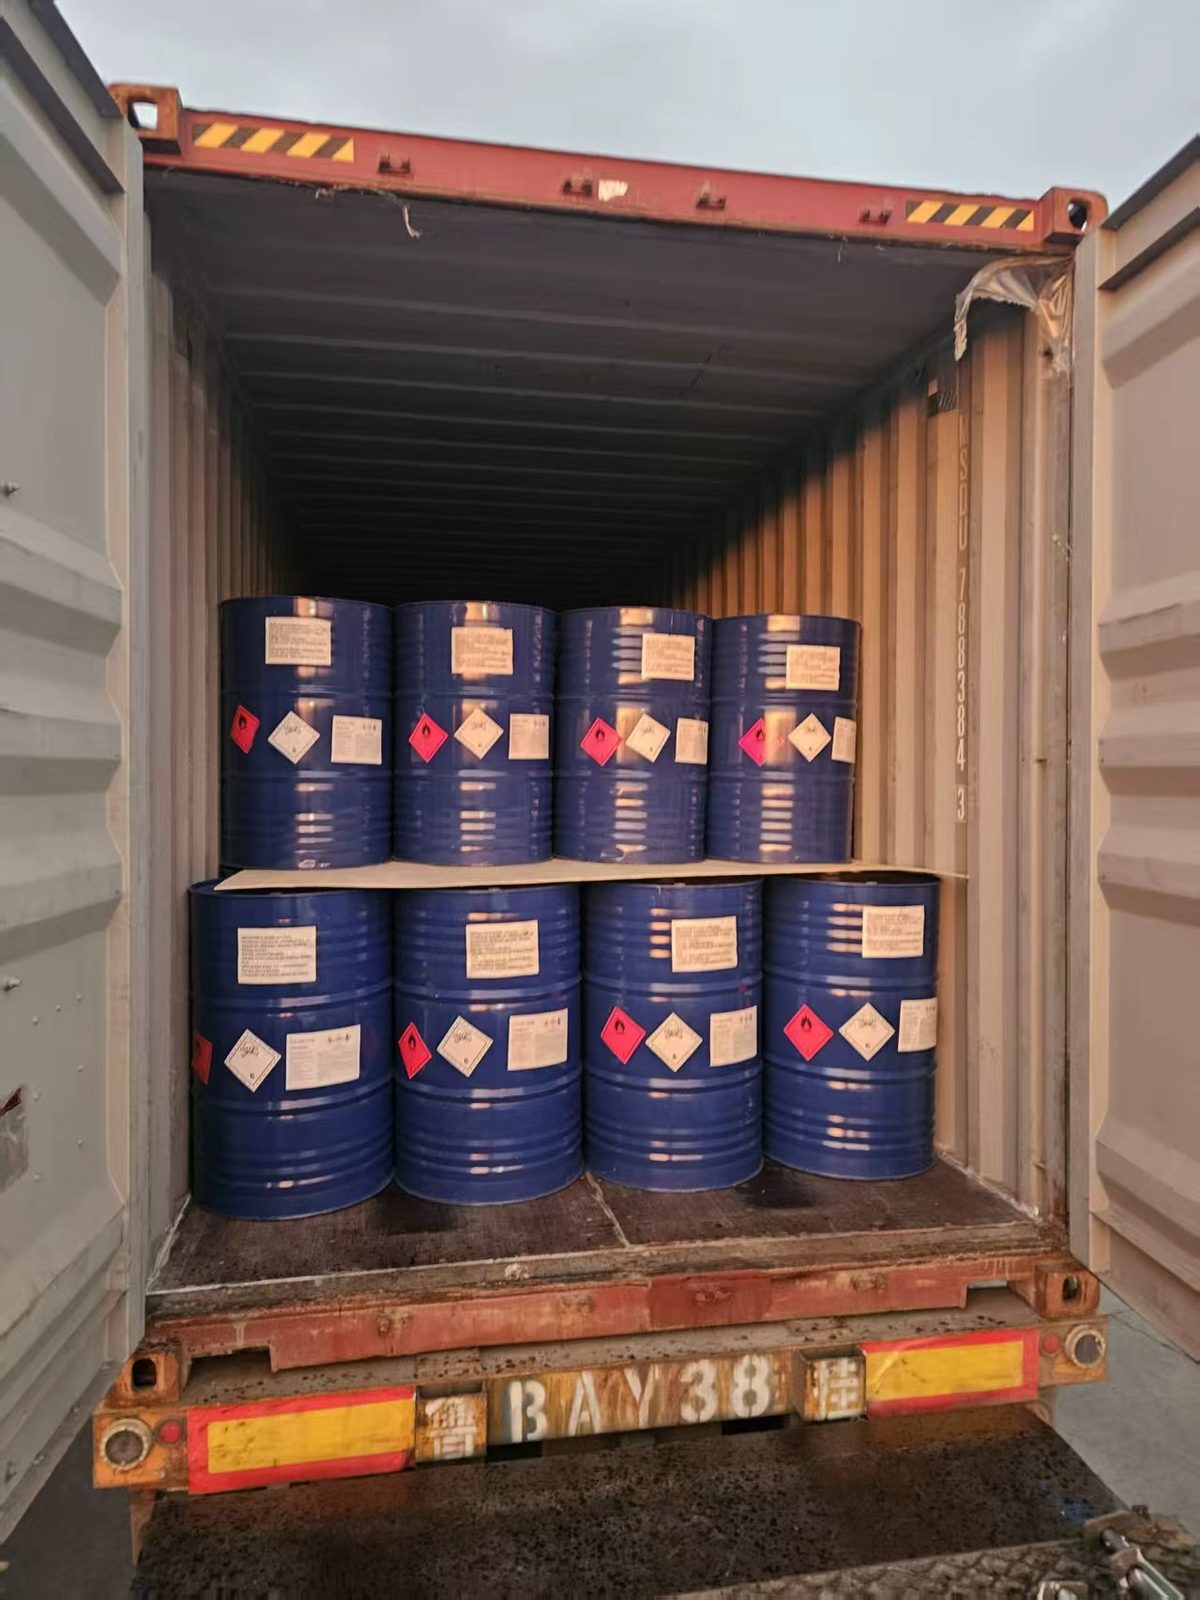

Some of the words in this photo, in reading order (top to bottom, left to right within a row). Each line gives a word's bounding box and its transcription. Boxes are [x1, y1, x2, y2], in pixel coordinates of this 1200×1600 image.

[956, 567, 967, 772] 788384
[956, 786, 965, 821] 3
[508, 1353, 772, 1444] BAY38
